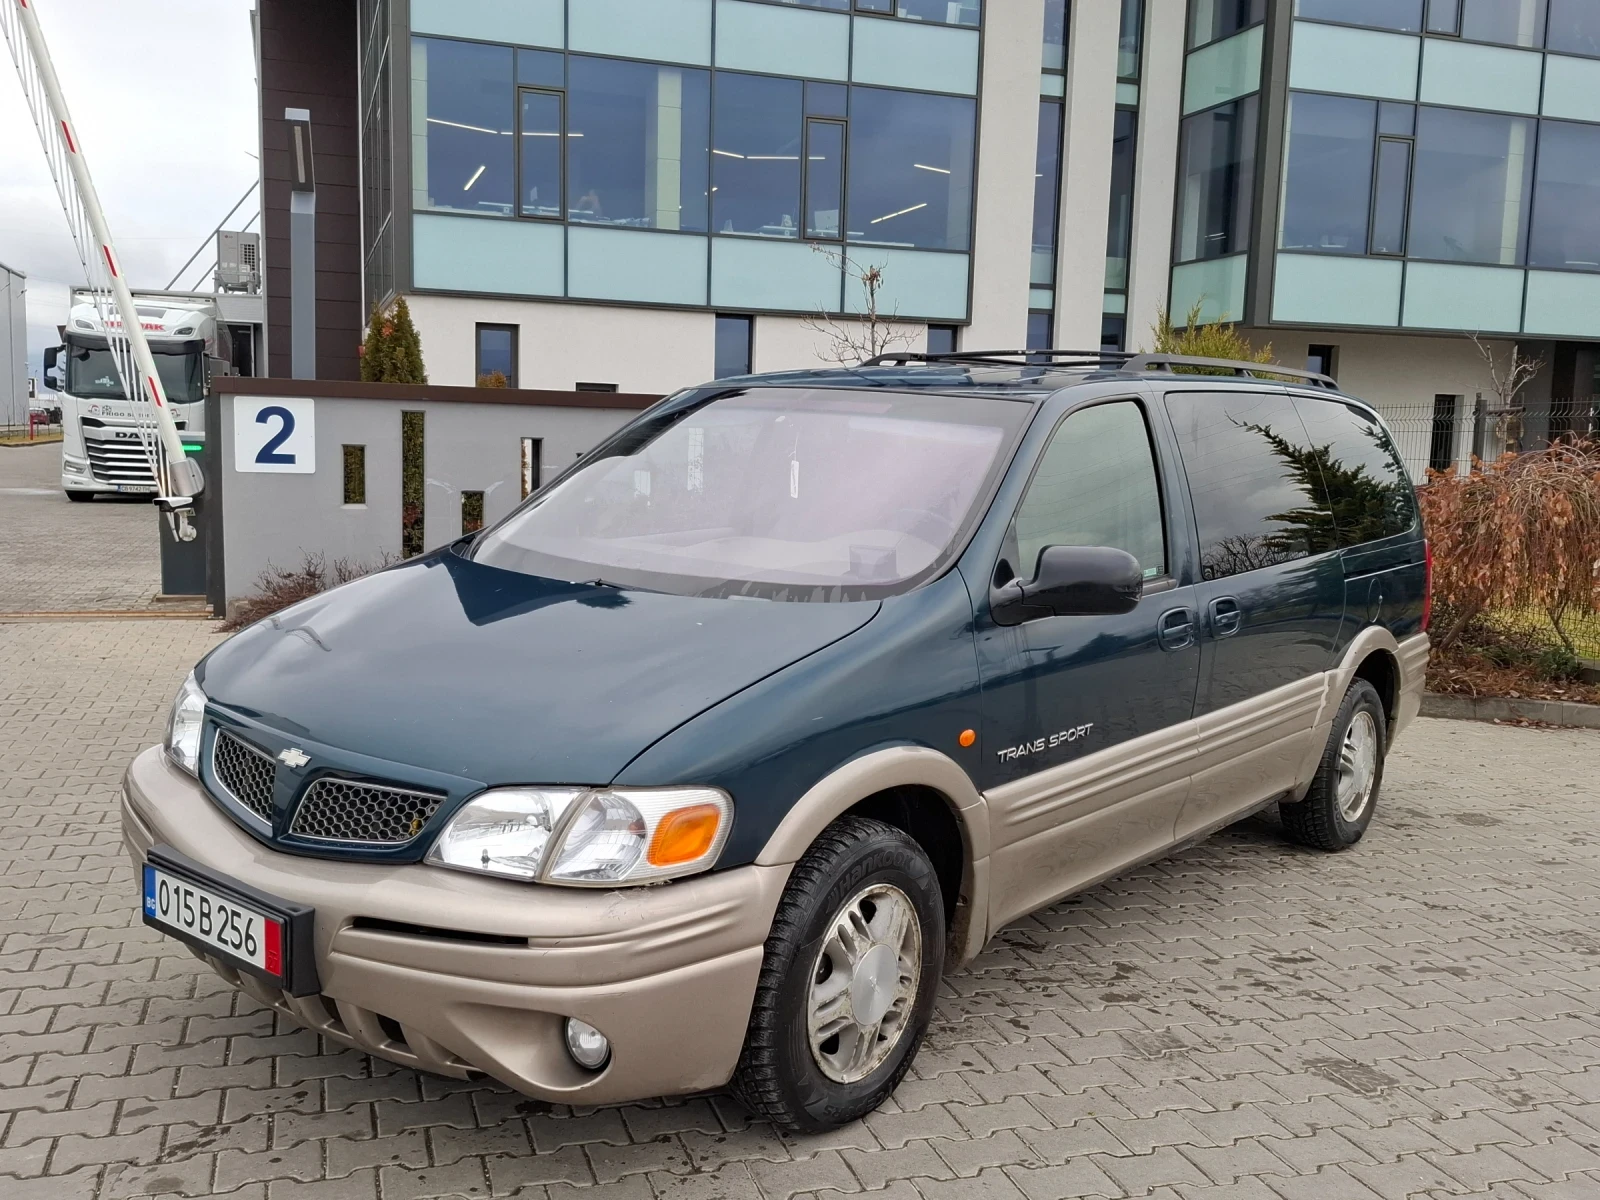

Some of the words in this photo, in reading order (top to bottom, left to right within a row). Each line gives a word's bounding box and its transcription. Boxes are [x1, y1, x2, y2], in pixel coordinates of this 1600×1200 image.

[255, 405, 296, 465] 2
[997, 738, 1046, 763] TRANS
[1048, 723, 1094, 748] SPORT
[146, 896, 156, 910] BG
